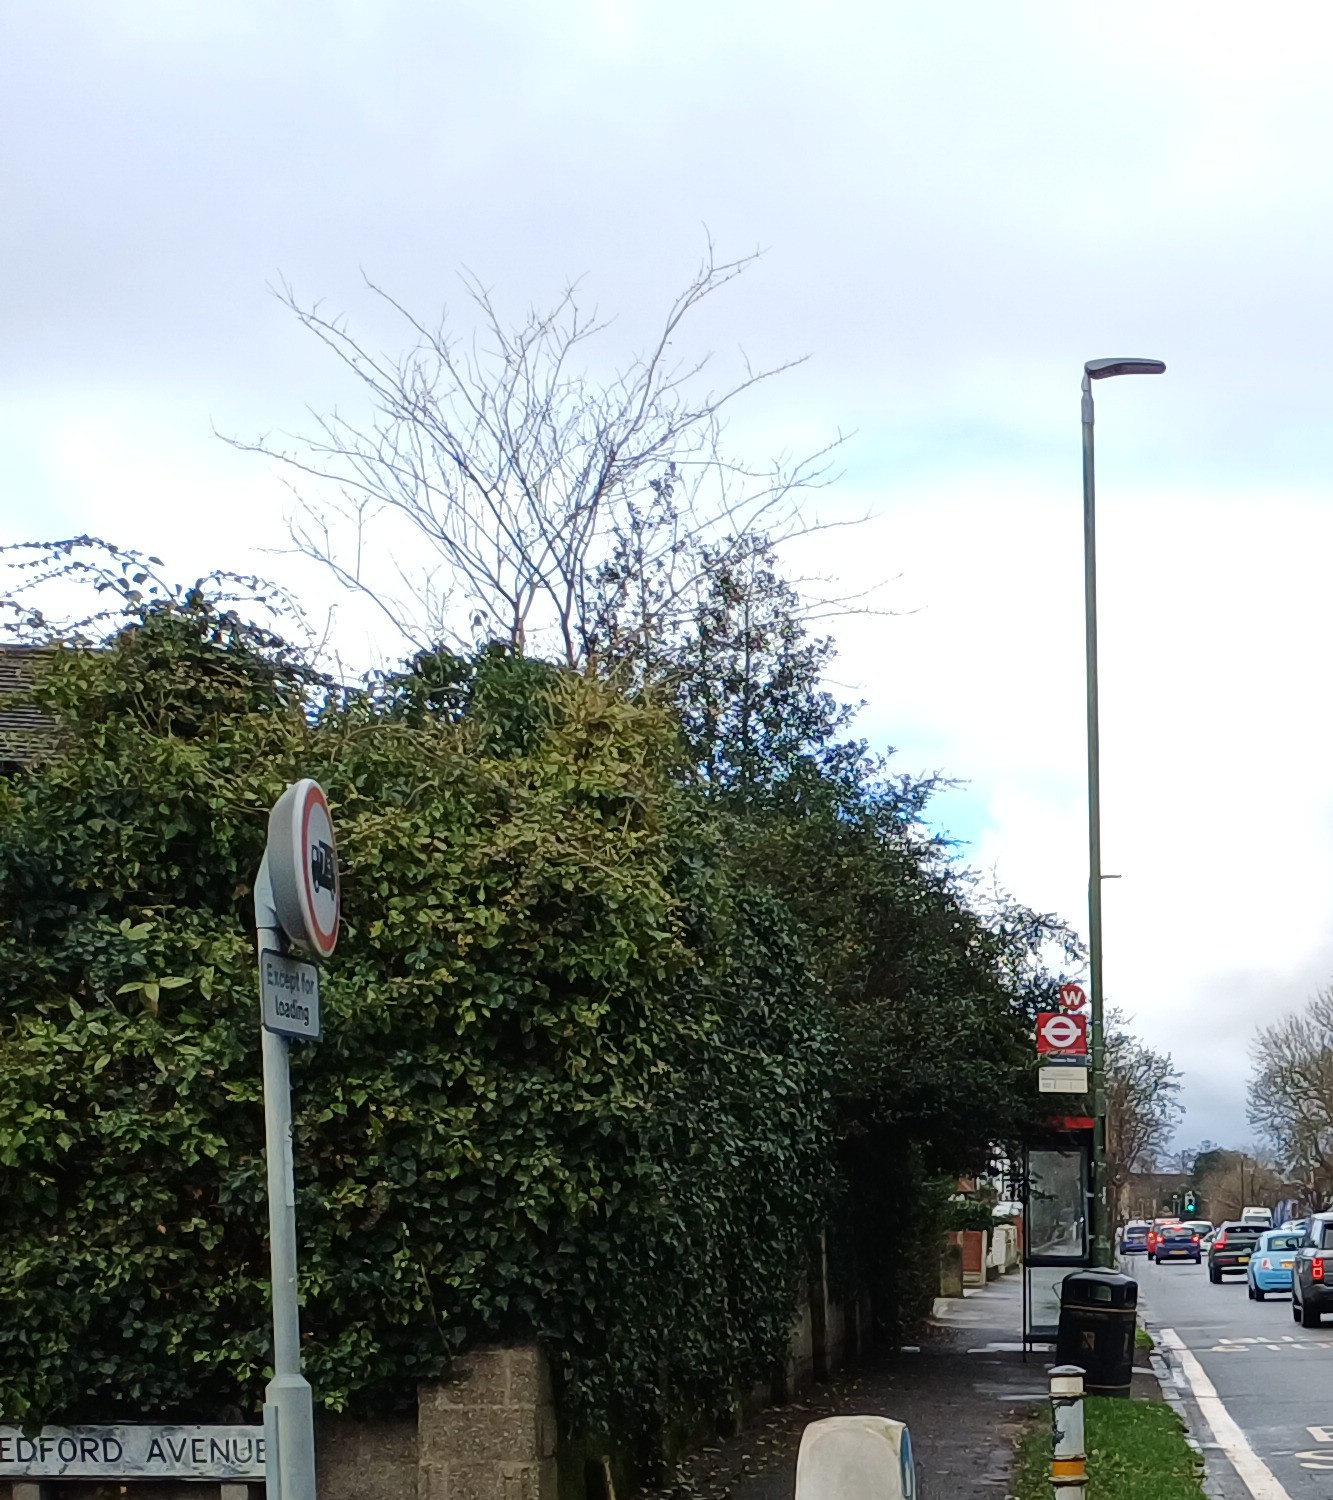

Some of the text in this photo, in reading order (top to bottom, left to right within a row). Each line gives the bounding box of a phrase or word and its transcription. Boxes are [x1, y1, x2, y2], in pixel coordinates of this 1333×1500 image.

[266, 963, 315, 995] Except for
[275, 995, 309, 1026] loading
[1062, 990, 1082, 1006] W
[146, 1438, 266, 1464] AVENUE
